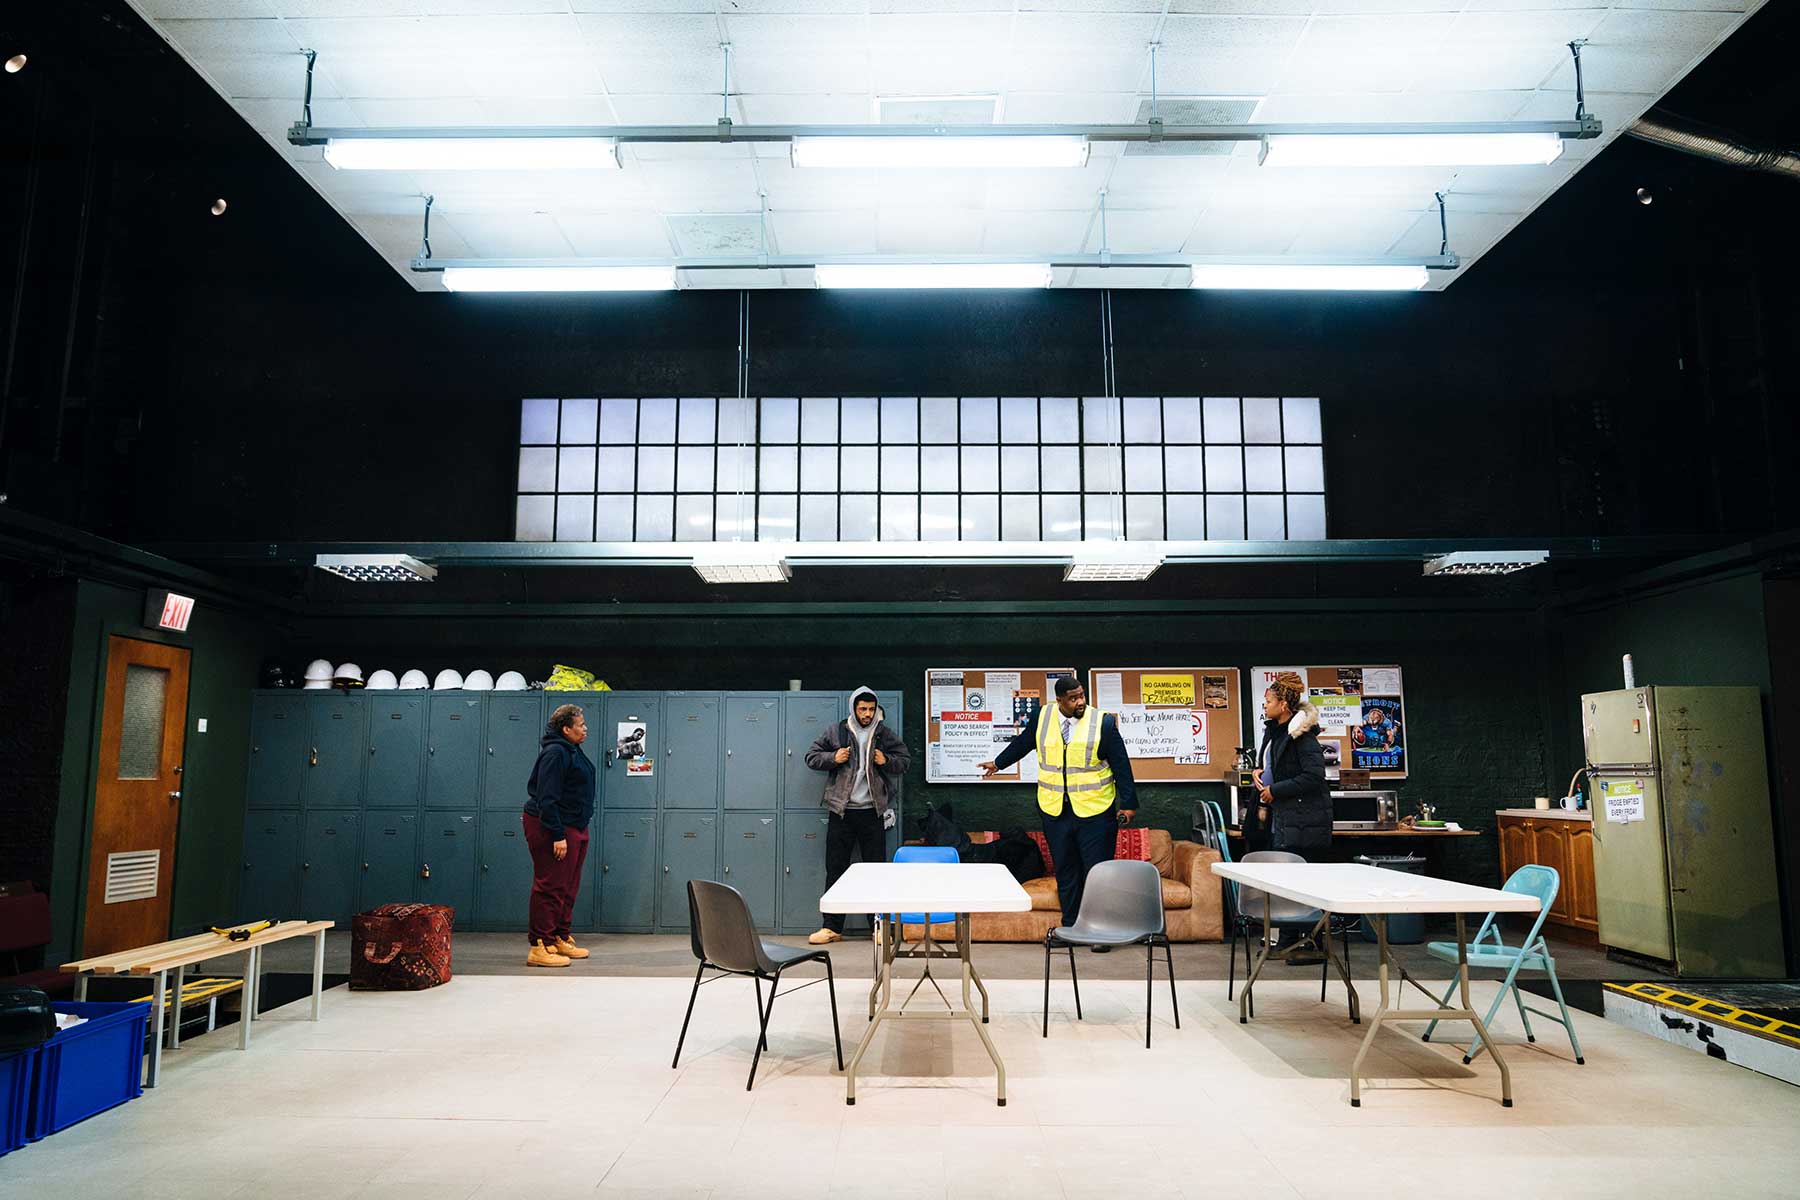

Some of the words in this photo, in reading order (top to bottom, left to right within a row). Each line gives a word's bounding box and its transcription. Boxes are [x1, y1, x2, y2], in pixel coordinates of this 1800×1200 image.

[162, 596, 192, 628] EXIT
[1361, 699, 1400, 710] TROIT
[1147, 725, 1164, 737] NO?
[1358, 755, 1399, 765] LIONS
[1614, 785, 1632, 793] NOTICE
